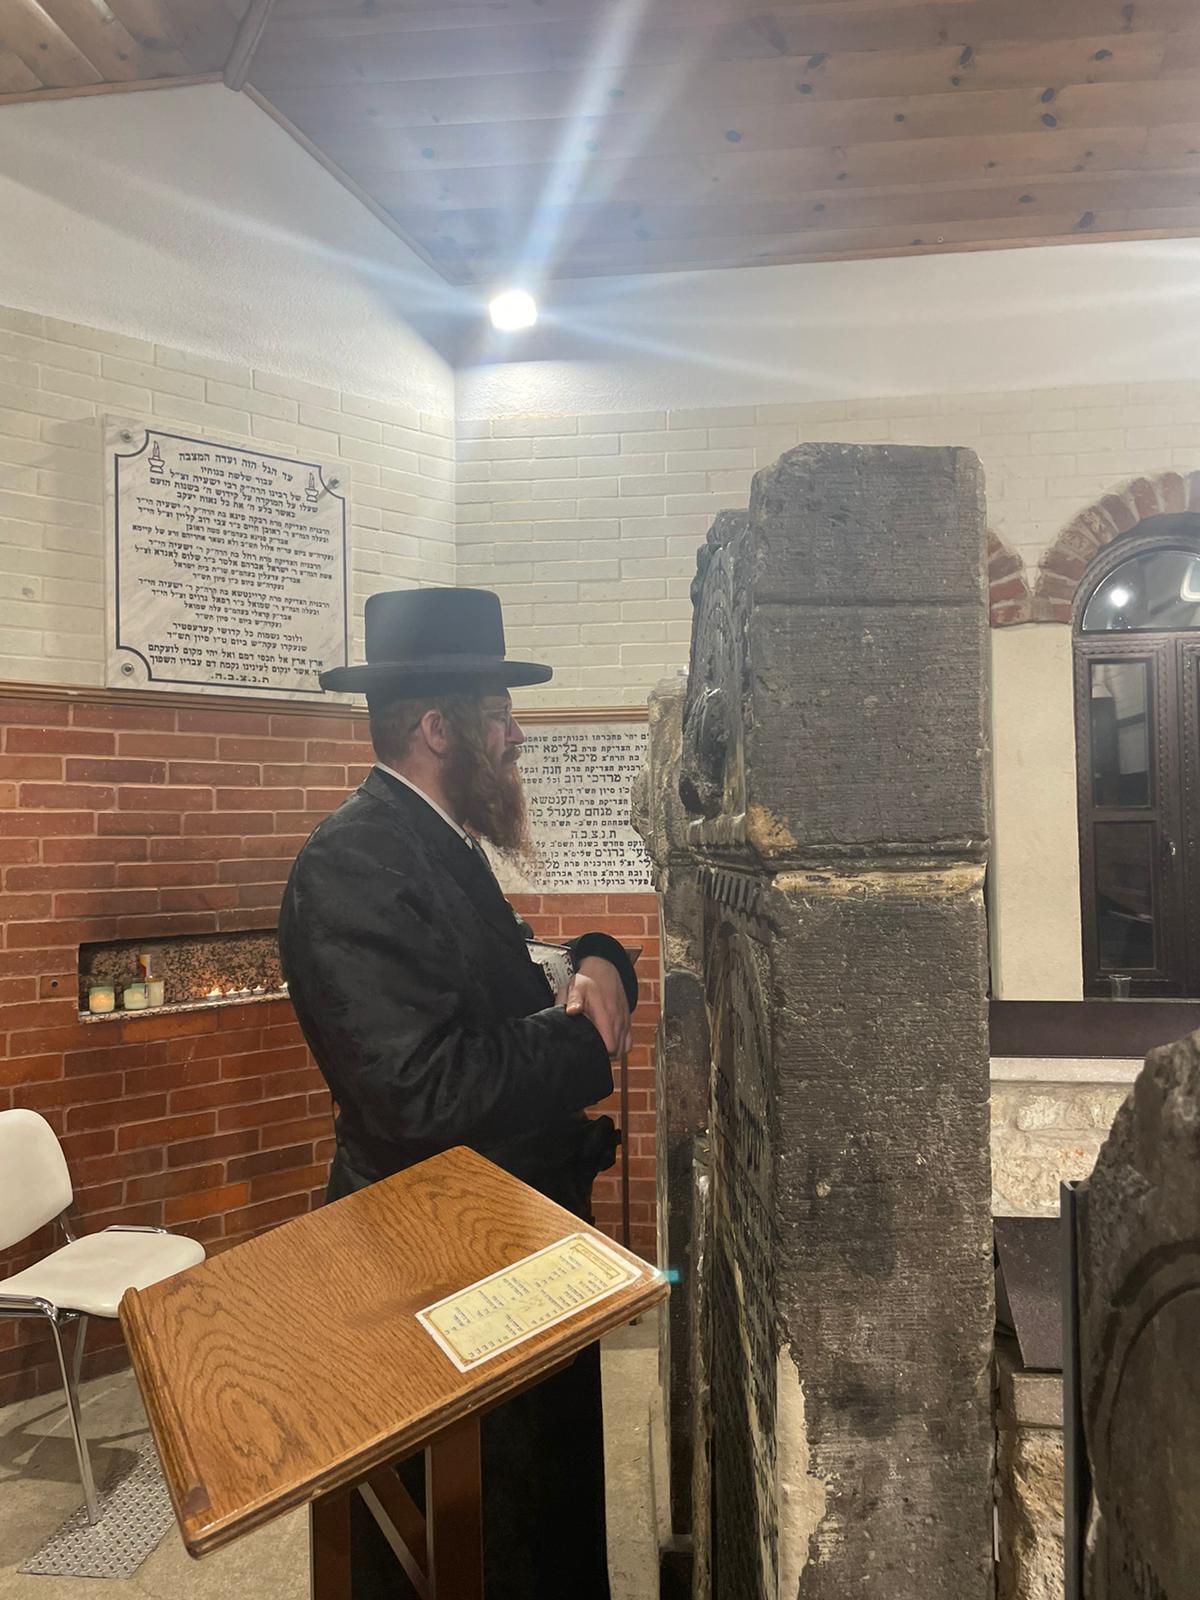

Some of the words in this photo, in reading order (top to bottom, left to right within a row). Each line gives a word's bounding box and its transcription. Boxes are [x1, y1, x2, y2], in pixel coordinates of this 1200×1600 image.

[563, 753, 597, 762] מיכאל
[565, 775, 582, 783] דוב
[588, 774, 621, 782] מרדכי
[547, 806, 580, 817] מענדל
[585, 808, 612, 816] מנחם
[594, 878, 625, 886] ברוקלין
